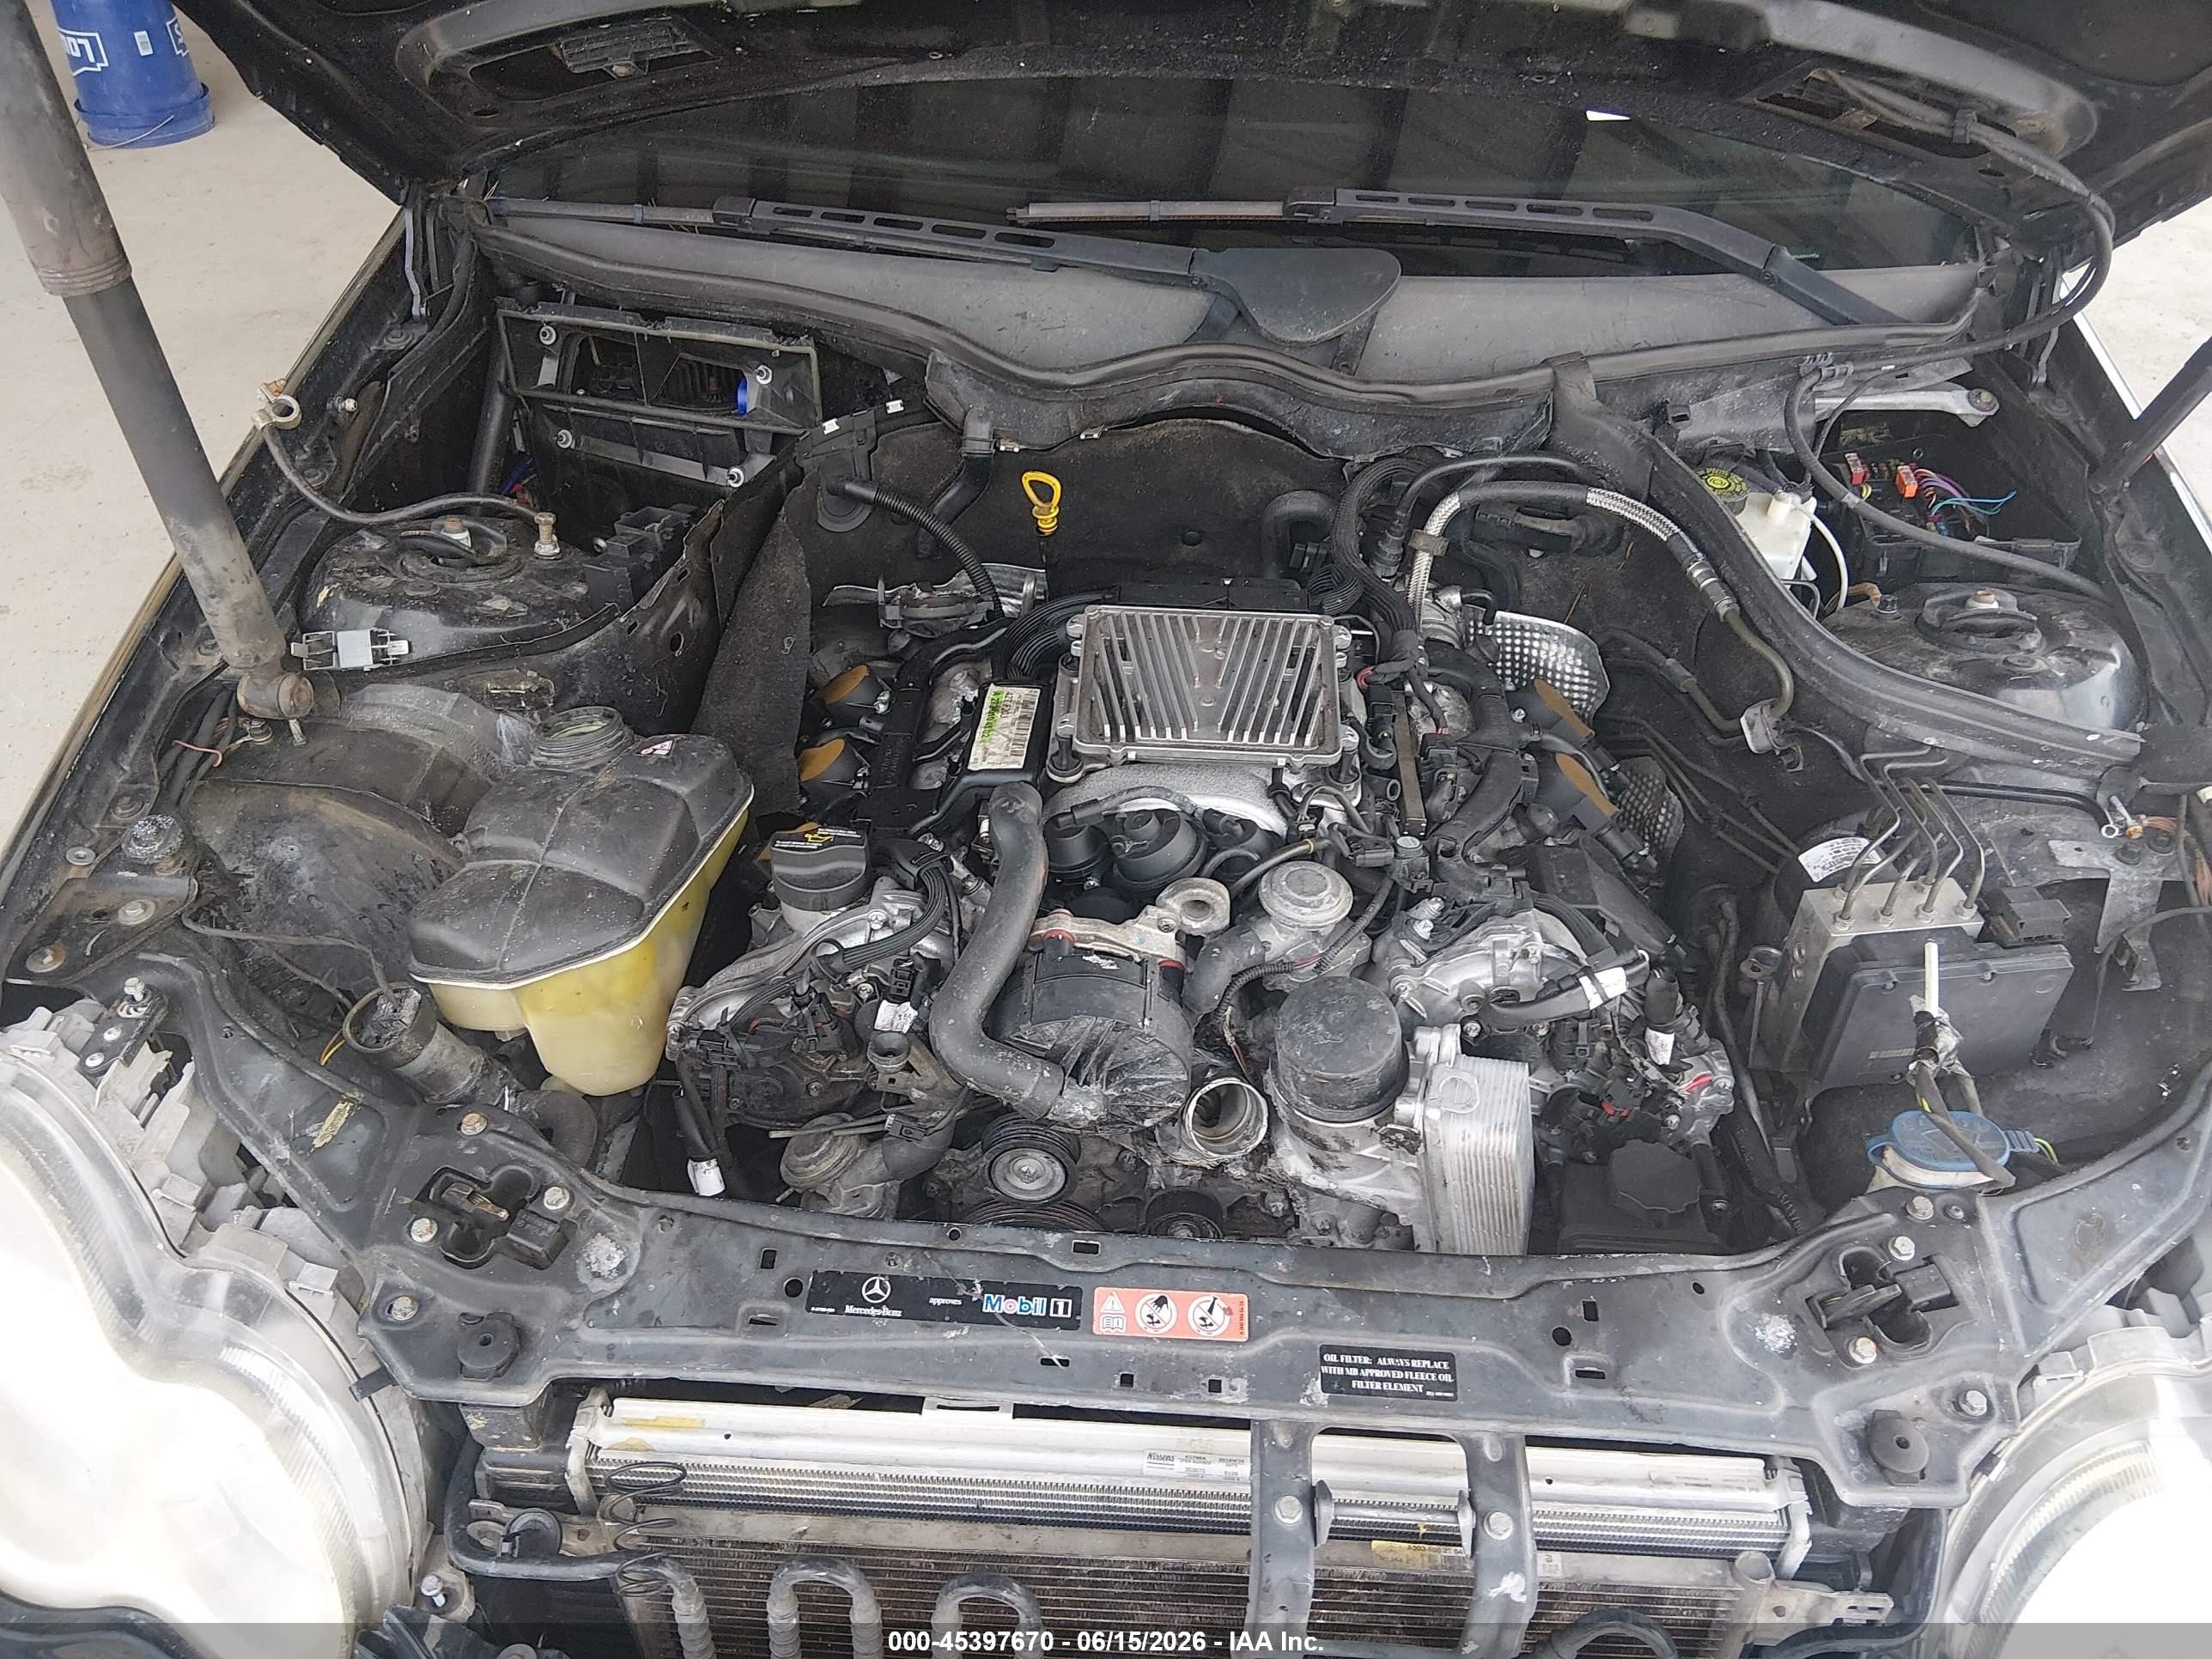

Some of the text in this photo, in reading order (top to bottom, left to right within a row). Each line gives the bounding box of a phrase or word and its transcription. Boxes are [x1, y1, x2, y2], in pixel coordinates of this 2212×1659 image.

[845, 1304, 902, 1316] Mercedes-Benz
[929, 1297, 963, 1306] approves
[982, 1294, 1047, 1316] Mobil
[1323, 1353, 1449, 1370] OIL FILTER: ALWAYS REPLACE
[1321, 1365, 1344, 1375] WITH
[1360, 1369, 1403, 1379] APPROVED
[1404, 1371, 1437, 1381] FLEECE
[1437, 1374, 1455, 1382] OIL
[1352, 1380, 1424, 1393] FILTER ELEMENT
[1146, 1452, 1175, 1462] Nissens
